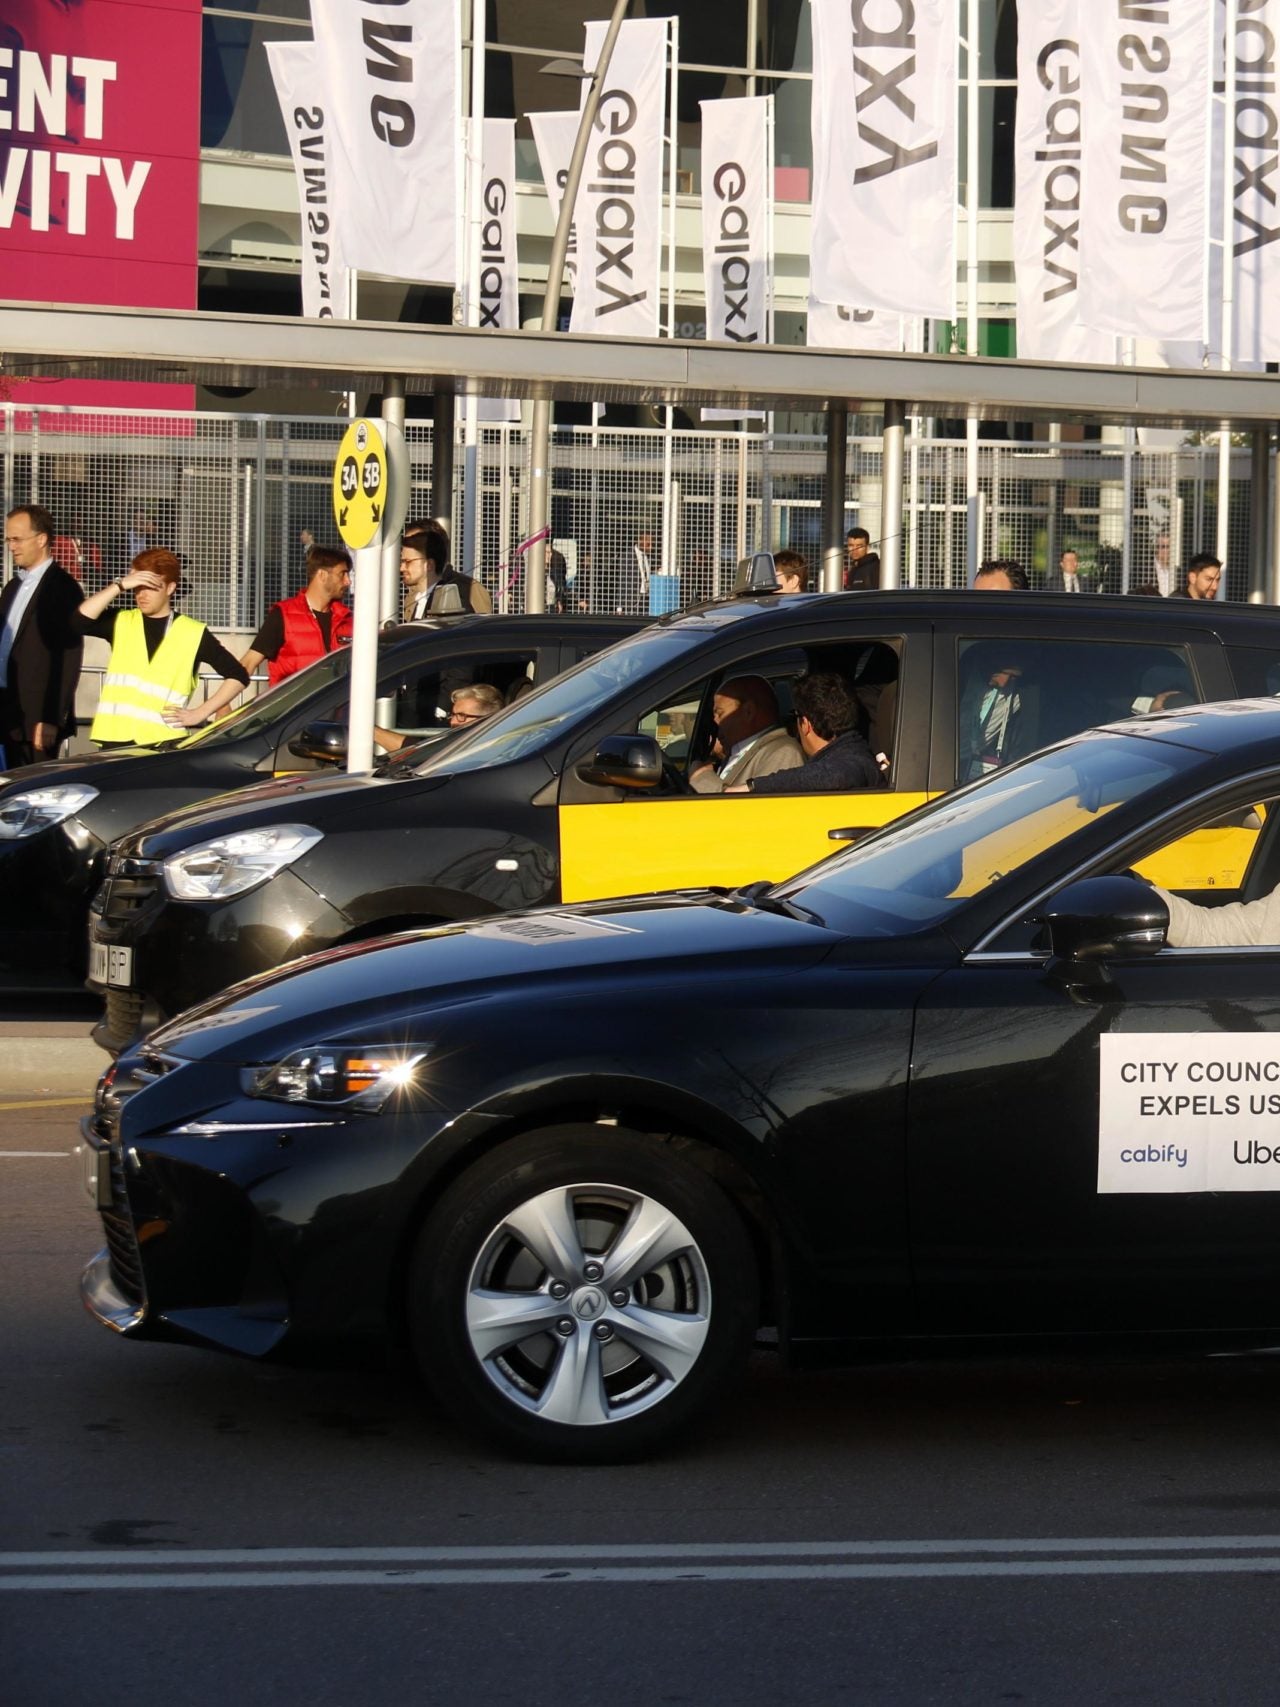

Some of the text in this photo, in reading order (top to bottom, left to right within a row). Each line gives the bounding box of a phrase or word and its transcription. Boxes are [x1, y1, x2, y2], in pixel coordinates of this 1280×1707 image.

[342, 461, 380, 491] 3A 3B
[1120, 1062, 1179, 1083] CITY
[1140, 1094, 1240, 1116] EXPELS
[1120, 1144, 1188, 1168] cabify
